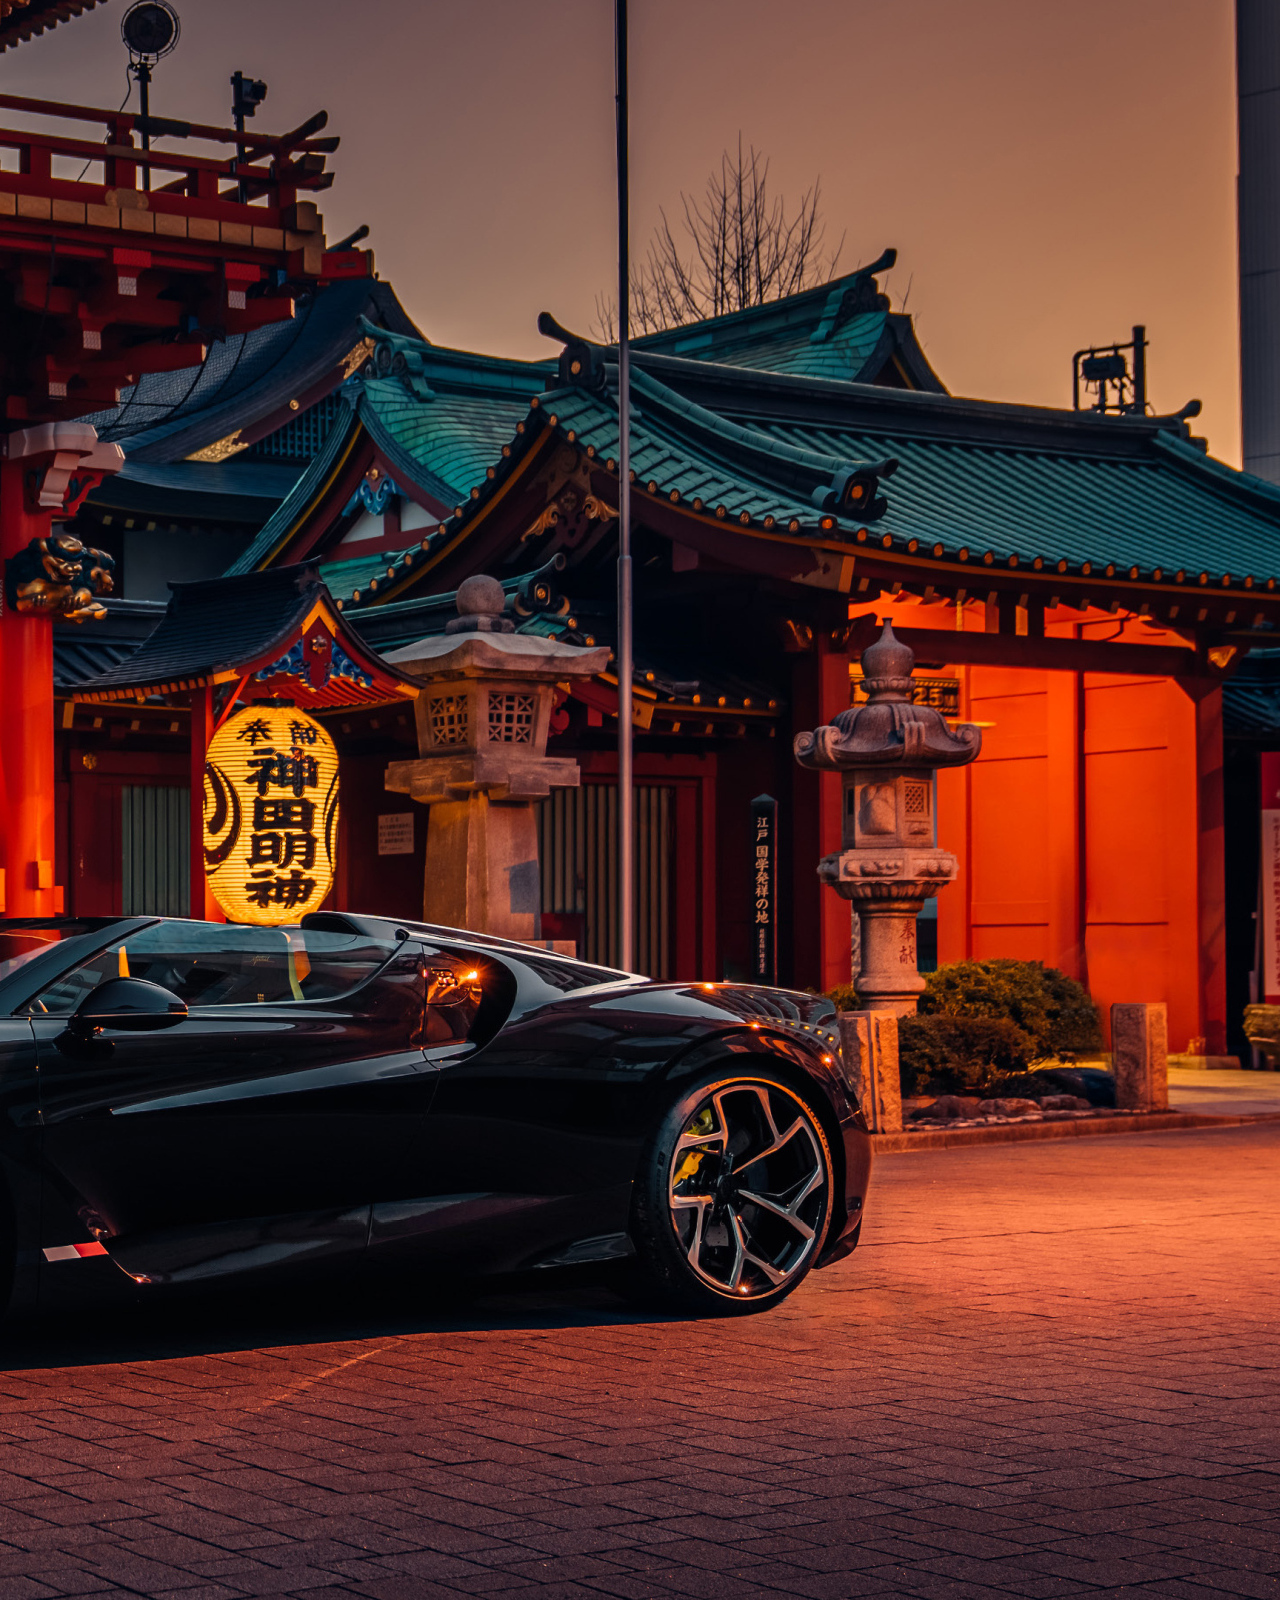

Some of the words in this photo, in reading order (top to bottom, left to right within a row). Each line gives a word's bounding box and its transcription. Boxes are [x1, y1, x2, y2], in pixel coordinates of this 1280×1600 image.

[243, 747, 321, 909] 神田明神
[756, 817, 769, 842] 江戸
[755, 845, 769, 924] 国学発祥の地
